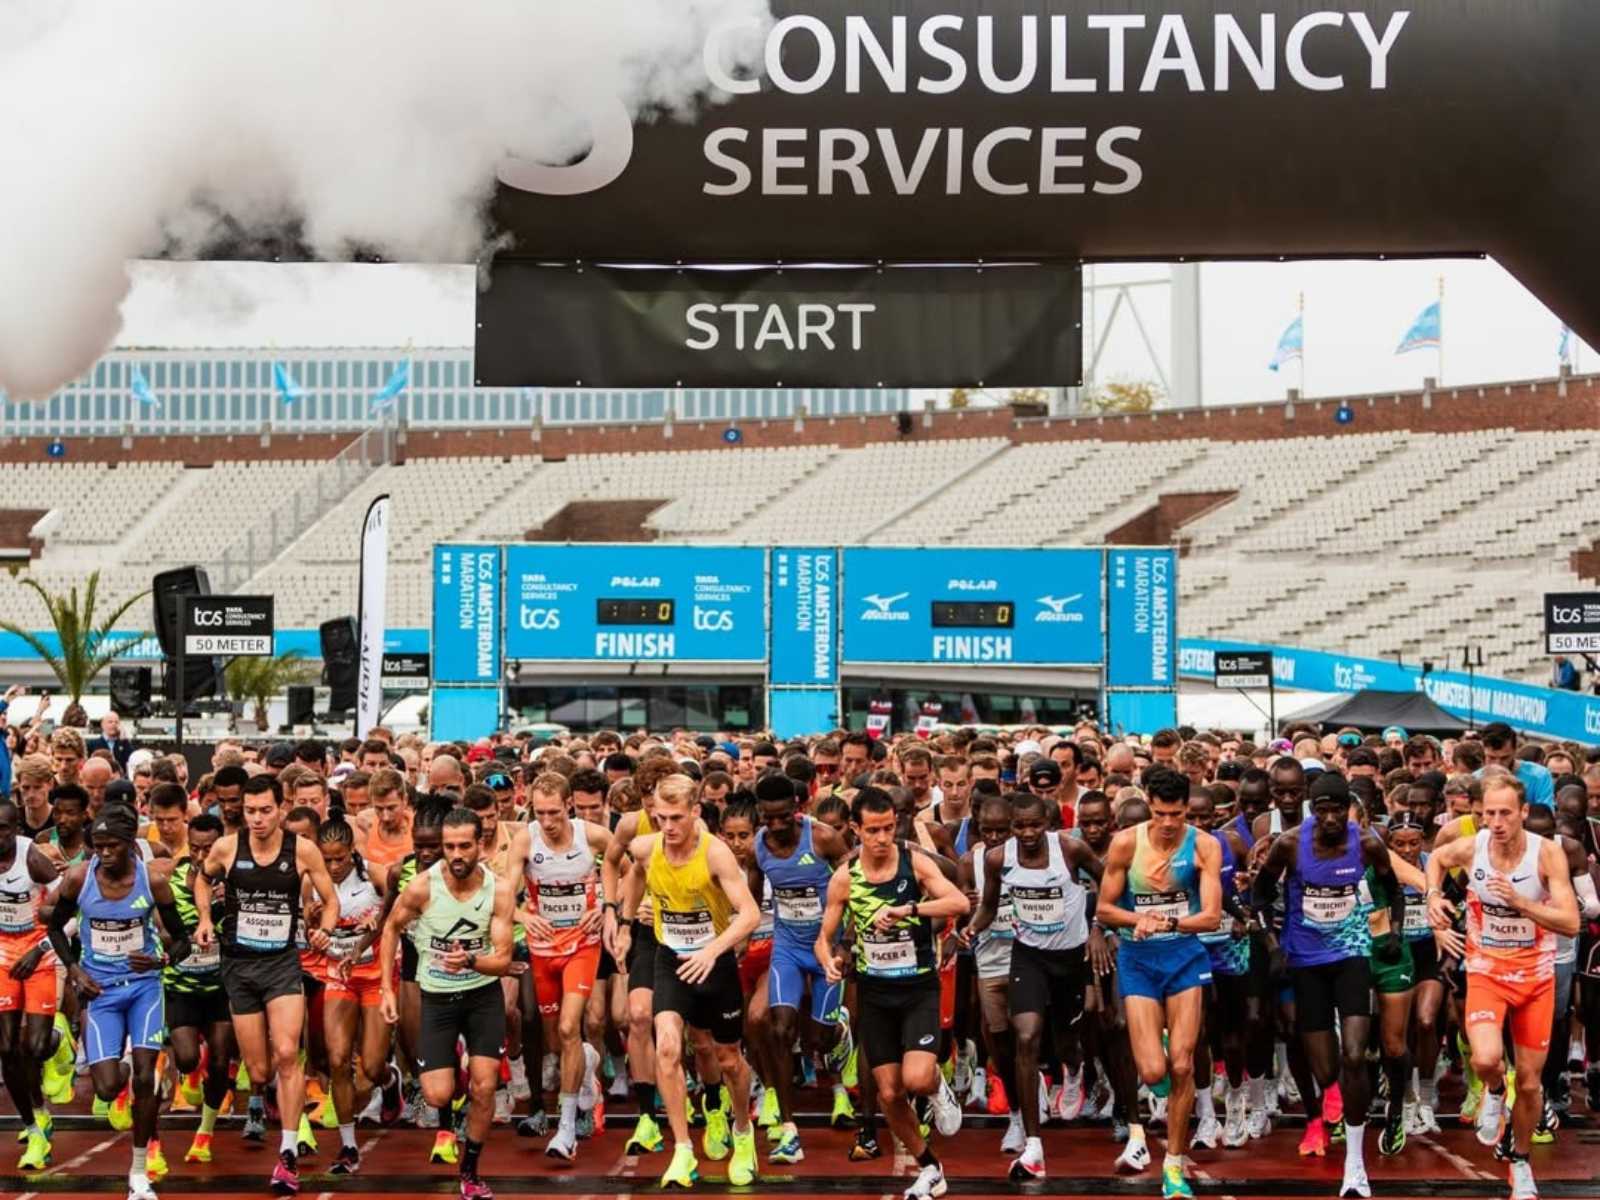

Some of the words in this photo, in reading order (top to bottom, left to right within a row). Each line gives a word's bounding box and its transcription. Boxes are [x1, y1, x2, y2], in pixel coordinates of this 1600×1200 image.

[702, 12, 1410, 95] CONSULTANCY
[702, 126, 1144, 196] SERVICES
[685, 303, 876, 351] START
[459, 552, 475, 630] MARATHON
[521, 583, 578, 591] CONSULTANCY
[610, 576, 661, 587] POLAR
[796, 554, 812, 632] MARATHON
[947, 579, 998, 590] POLAR
[1134, 557, 1150, 633] MARATHON
[194, 607, 223, 626] tcs
[520, 603, 560, 630] tcs
[693, 605, 734, 631] tcs
[1553, 605, 1581, 623] tcs
[477, 582, 493, 677] AMSTERDAM
[813, 584, 831, 679] AMSTERDAM
[1151, 586, 1168, 681] AMSTERDAM
[1556, 636, 1572, 648] 50
[196, 639, 214, 651] 50
[217, 639, 265, 651] METER
[595, 632, 676, 657] FINISH
[933, 636, 1013, 660] FINISH
[1492, 690, 1548, 726] MARATHON
[543, 903, 568, 912] PACER
[1490, 923, 1519, 934] PACER
[871, 952, 899, 961] PACER
